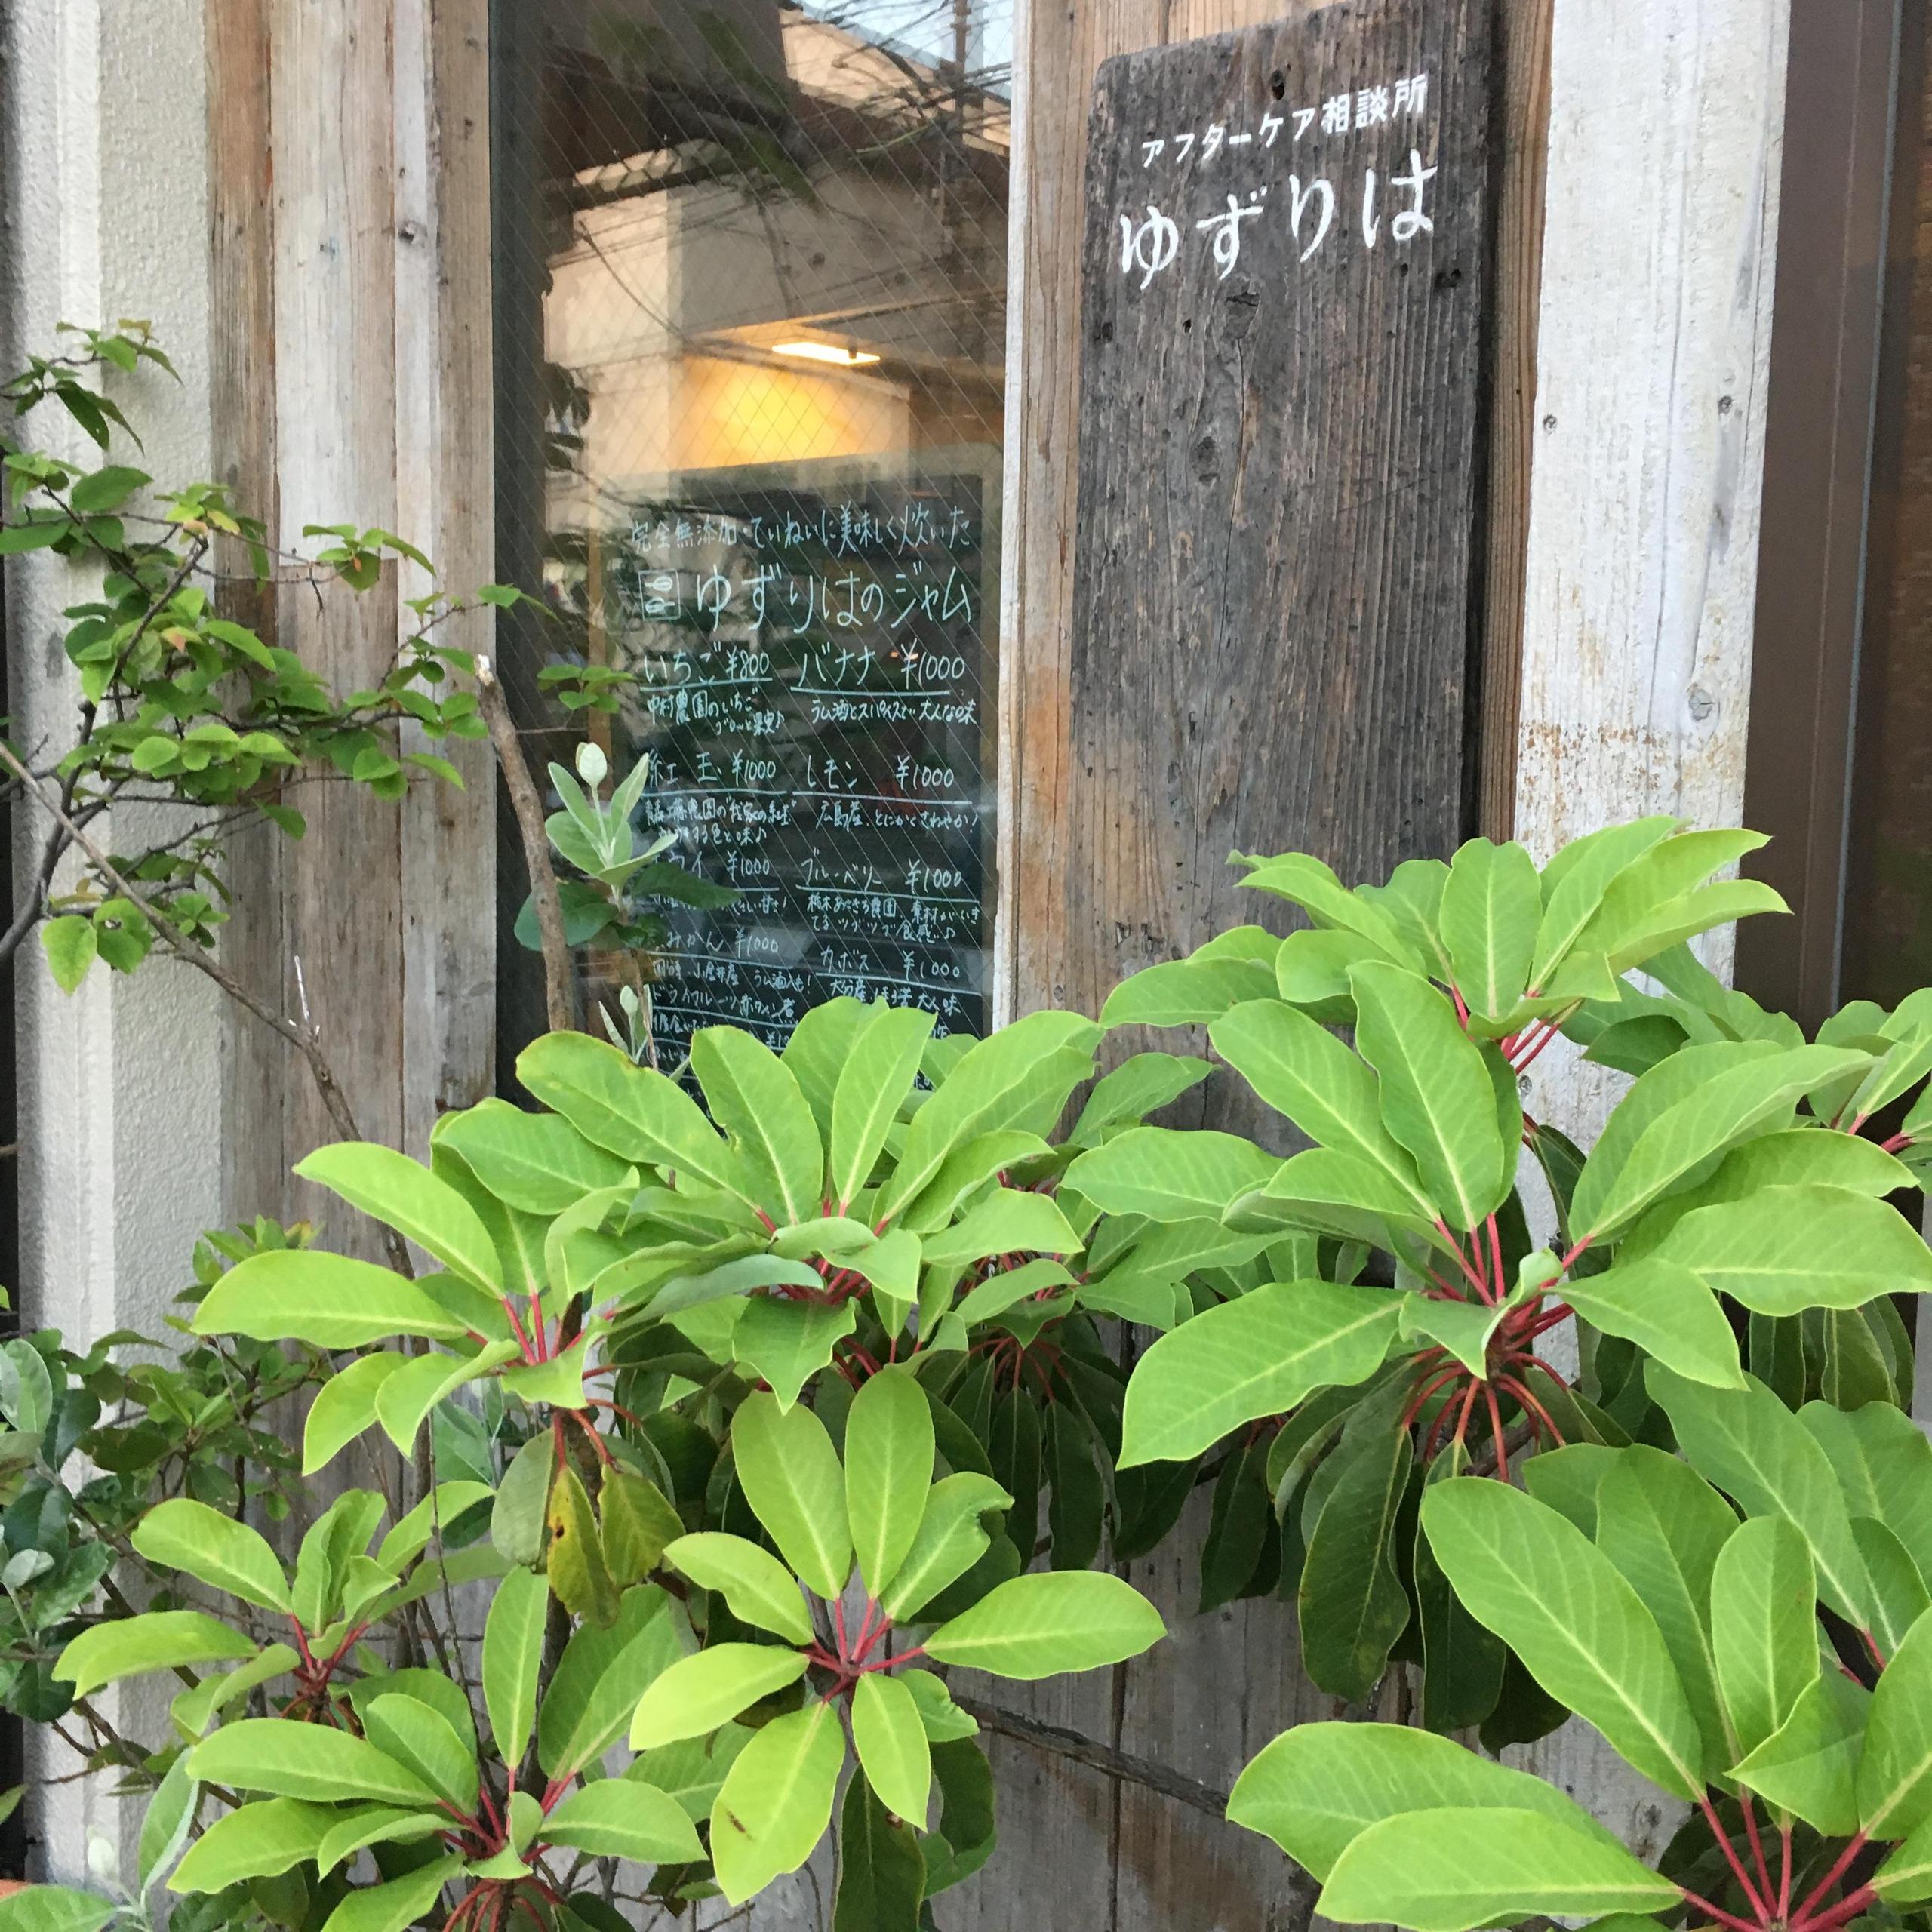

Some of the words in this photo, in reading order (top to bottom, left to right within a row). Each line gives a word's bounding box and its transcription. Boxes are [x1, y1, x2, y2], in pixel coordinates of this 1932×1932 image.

[1141, 74, 1426, 168] アフターケア相談所
[1120, 148, 1438, 291] ゆずりは
[696, 561, 972, 635] ゆずりはのジャム
[643, 641, 721, 685] いちご
[725, 645, 770, 681] ¥800
[798, 641, 876, 688] バナナ
[900, 637, 966, 690] ¥1000
[731, 748, 777, 787] ¥1000
[807, 755, 858, 789] レモン
[896, 755, 955, 791] ¥1000
[726, 850, 771, 882] ¥1000
[801, 847, 882, 891] ブルーベリー
[905, 857, 962, 894] ¥1000
[735, 926, 779, 959] ¥1000
[820, 944, 869, 974] カボス
[903, 949, 961, 981] ¥1000
